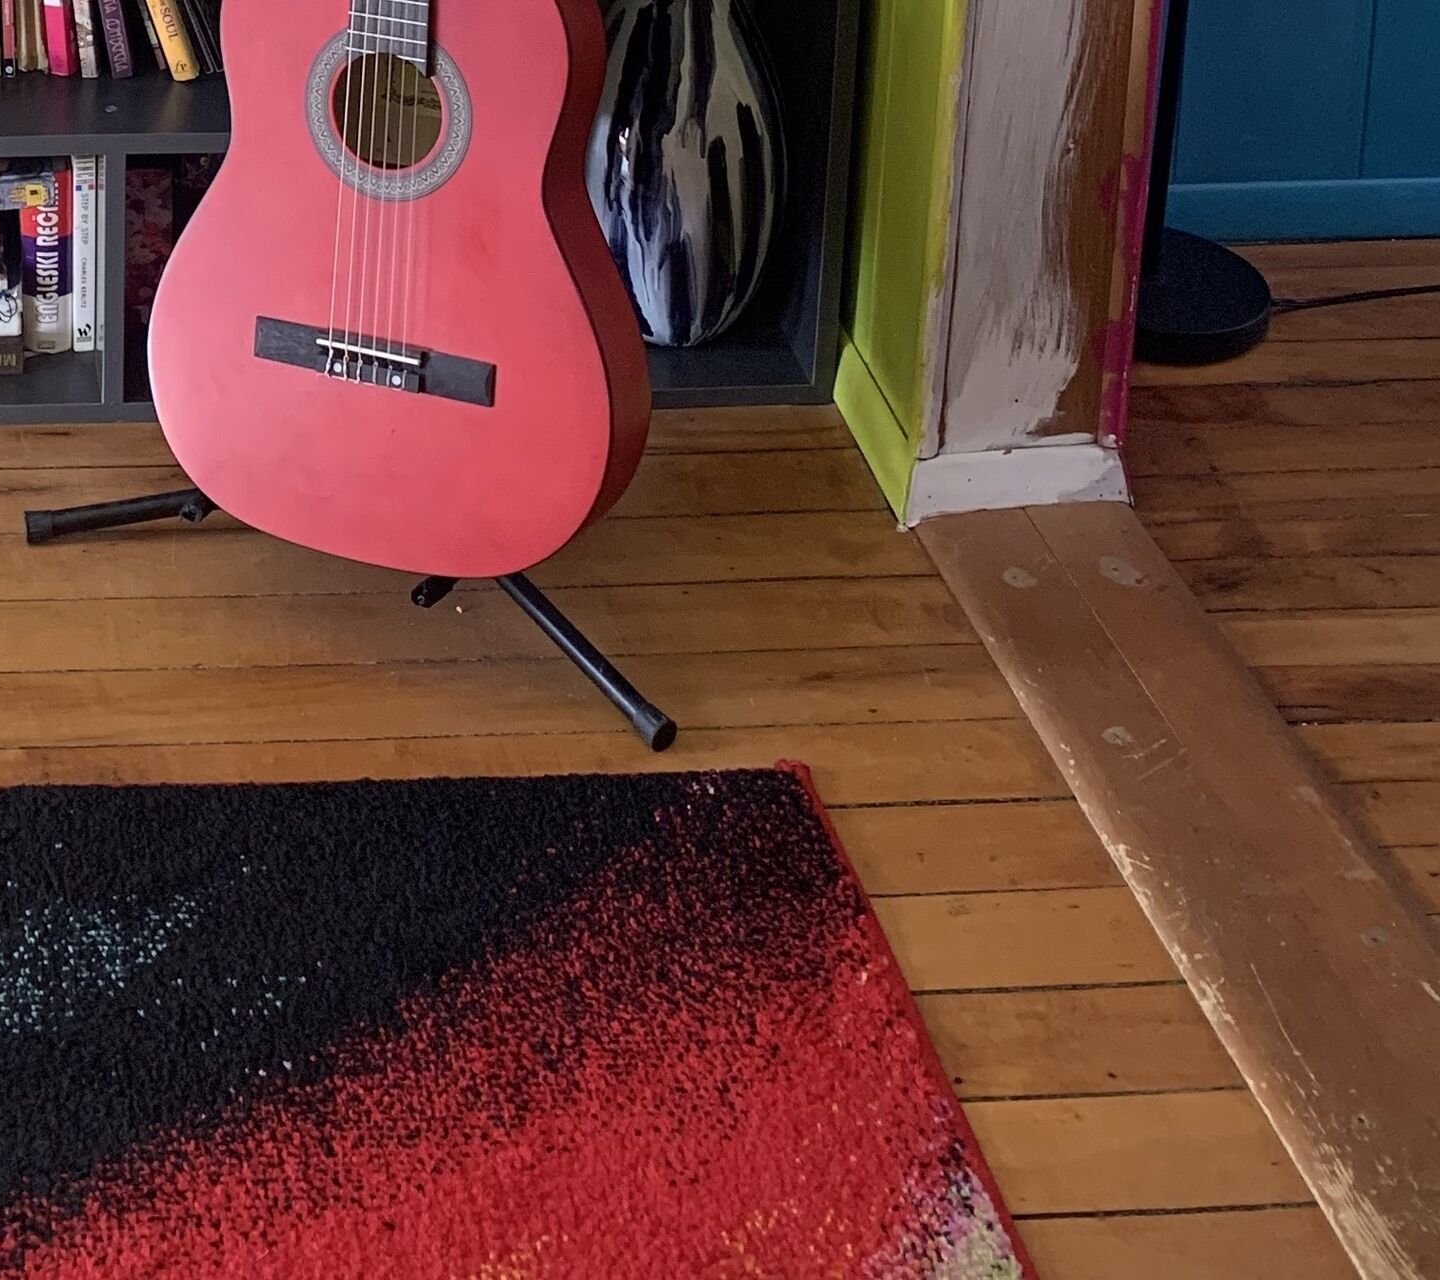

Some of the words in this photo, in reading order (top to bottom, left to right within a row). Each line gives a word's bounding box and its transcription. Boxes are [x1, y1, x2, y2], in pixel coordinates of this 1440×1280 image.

[161, 7, 178, 42] SOUL
[80, 192, 89, 211] STEP
[80, 213, 89, 224] BY
[80, 226, 89, 246] STEP
[80, 257, 88, 284] CHARLES
[35, 251, 59, 324] ENGLESKI
